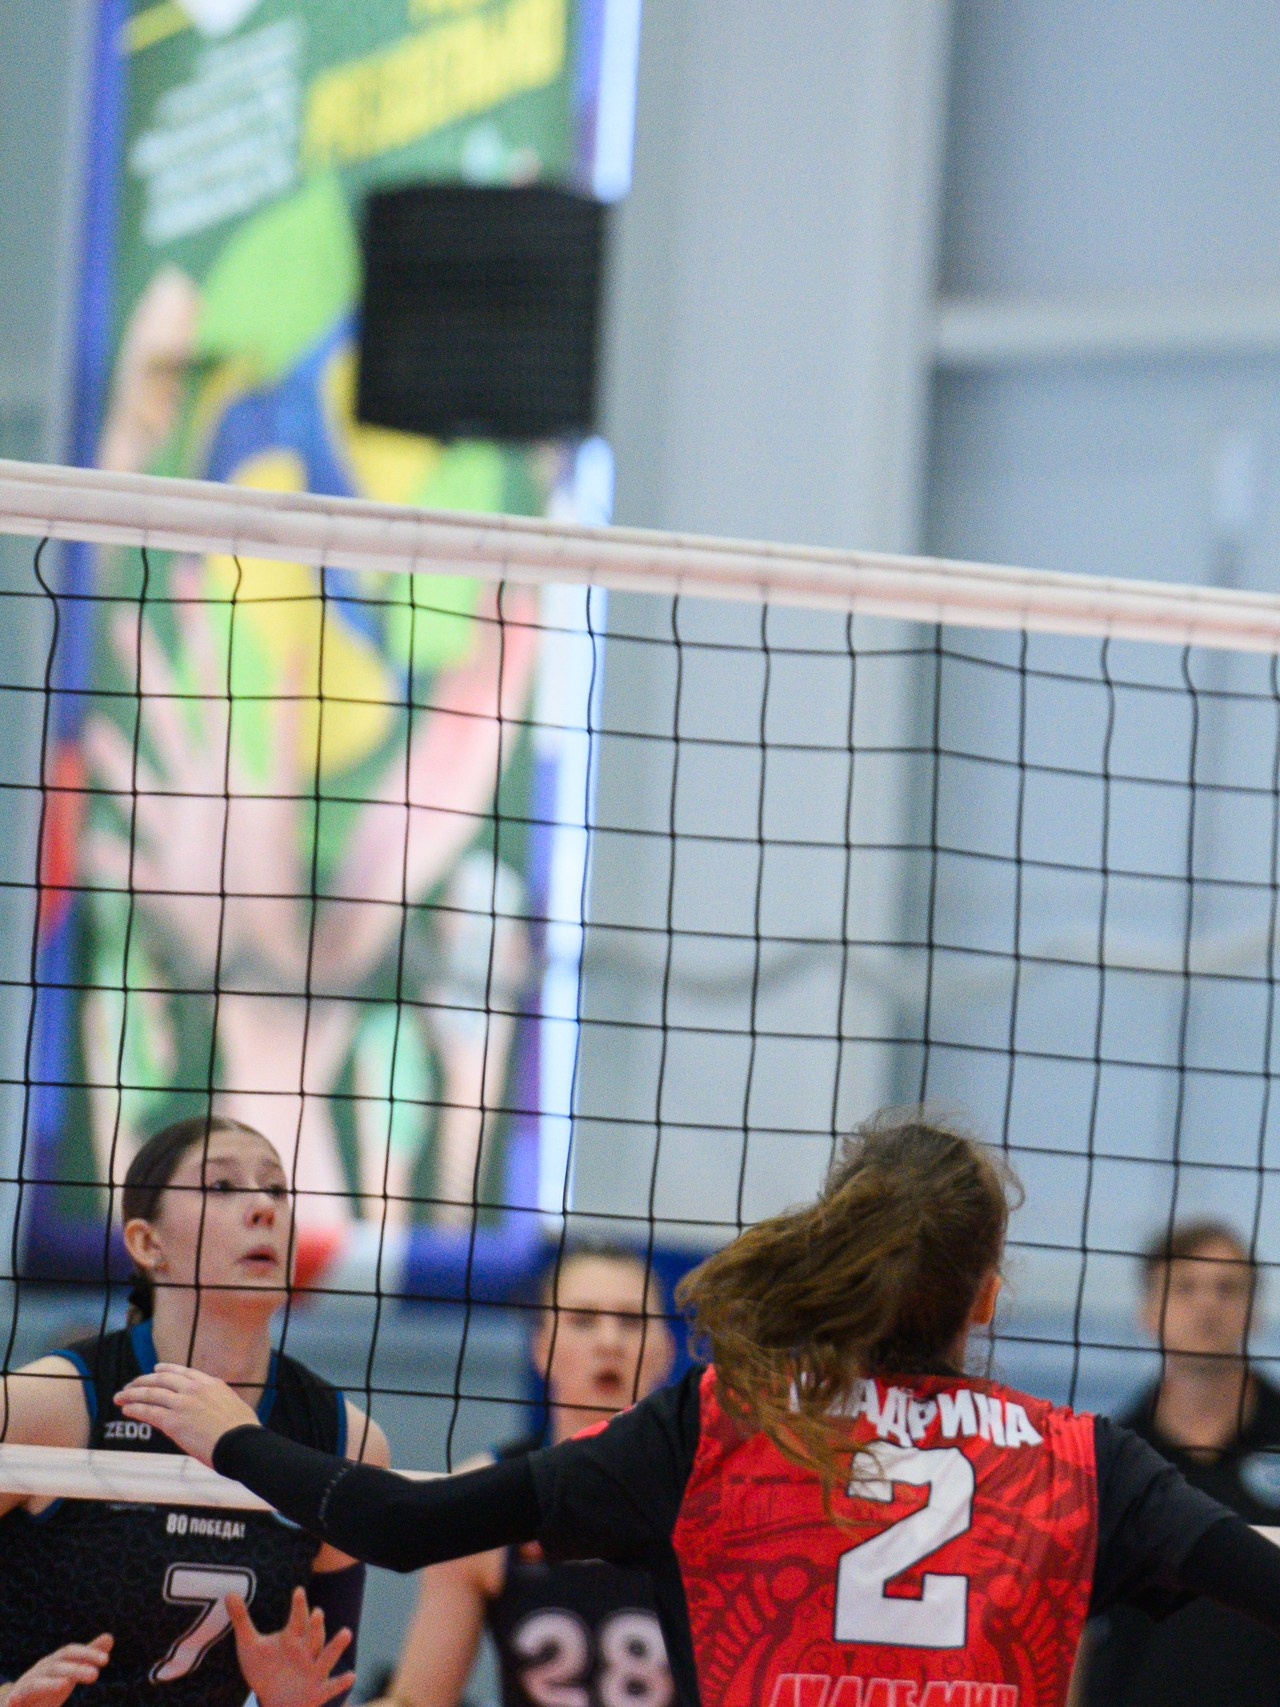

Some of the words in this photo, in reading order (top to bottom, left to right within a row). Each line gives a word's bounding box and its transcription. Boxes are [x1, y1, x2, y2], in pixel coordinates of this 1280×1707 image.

[166, 1512, 189, 1536] 80
[189, 1516, 246, 1541] ПОБЕДА!
[834, 1440, 976, 1649] 2
[149, 1562, 257, 1684] 7
[513, 1607, 676, 1707] 28
